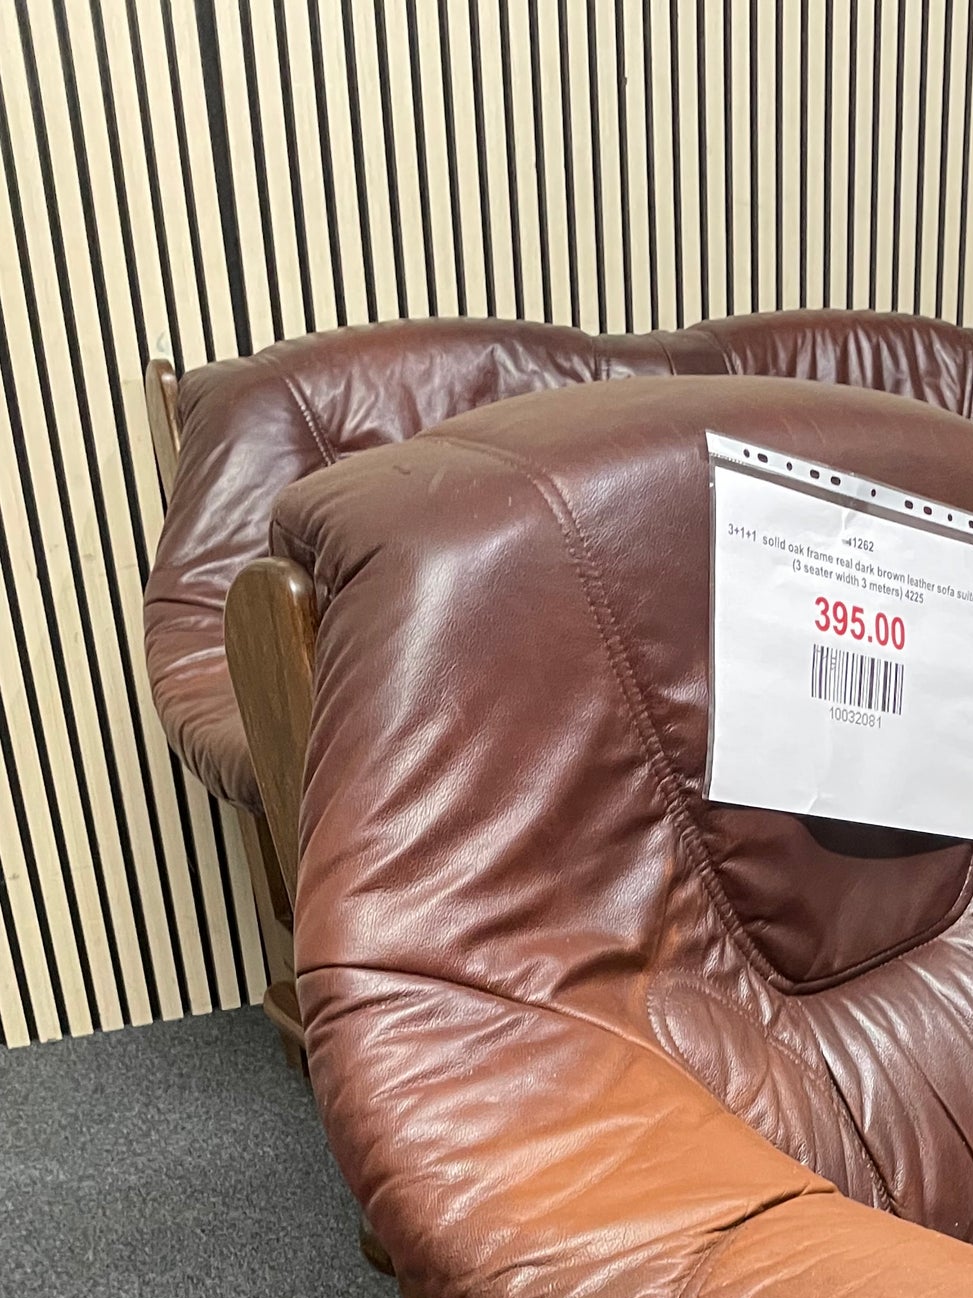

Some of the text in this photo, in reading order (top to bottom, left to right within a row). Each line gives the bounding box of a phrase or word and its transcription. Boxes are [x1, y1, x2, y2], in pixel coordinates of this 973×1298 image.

[728, 523, 757, 542] 3+1+1
[762, 535, 786, 550] solid
[788, 543, 805, 556] oak
[807, 546, 834, 564] frame
[836, 556, 853, 569] real
[855, 560, 875, 576] dark
[877, 566, 906, 582] brown
[907, 573, 936, 592] leather
[937, 584, 956, 598] sofa
[792, 558, 924, 604] (3 seater width 3 meters) 4225
[814, 596, 906, 651] 395.00
[830, 706, 883, 729] 10032081
